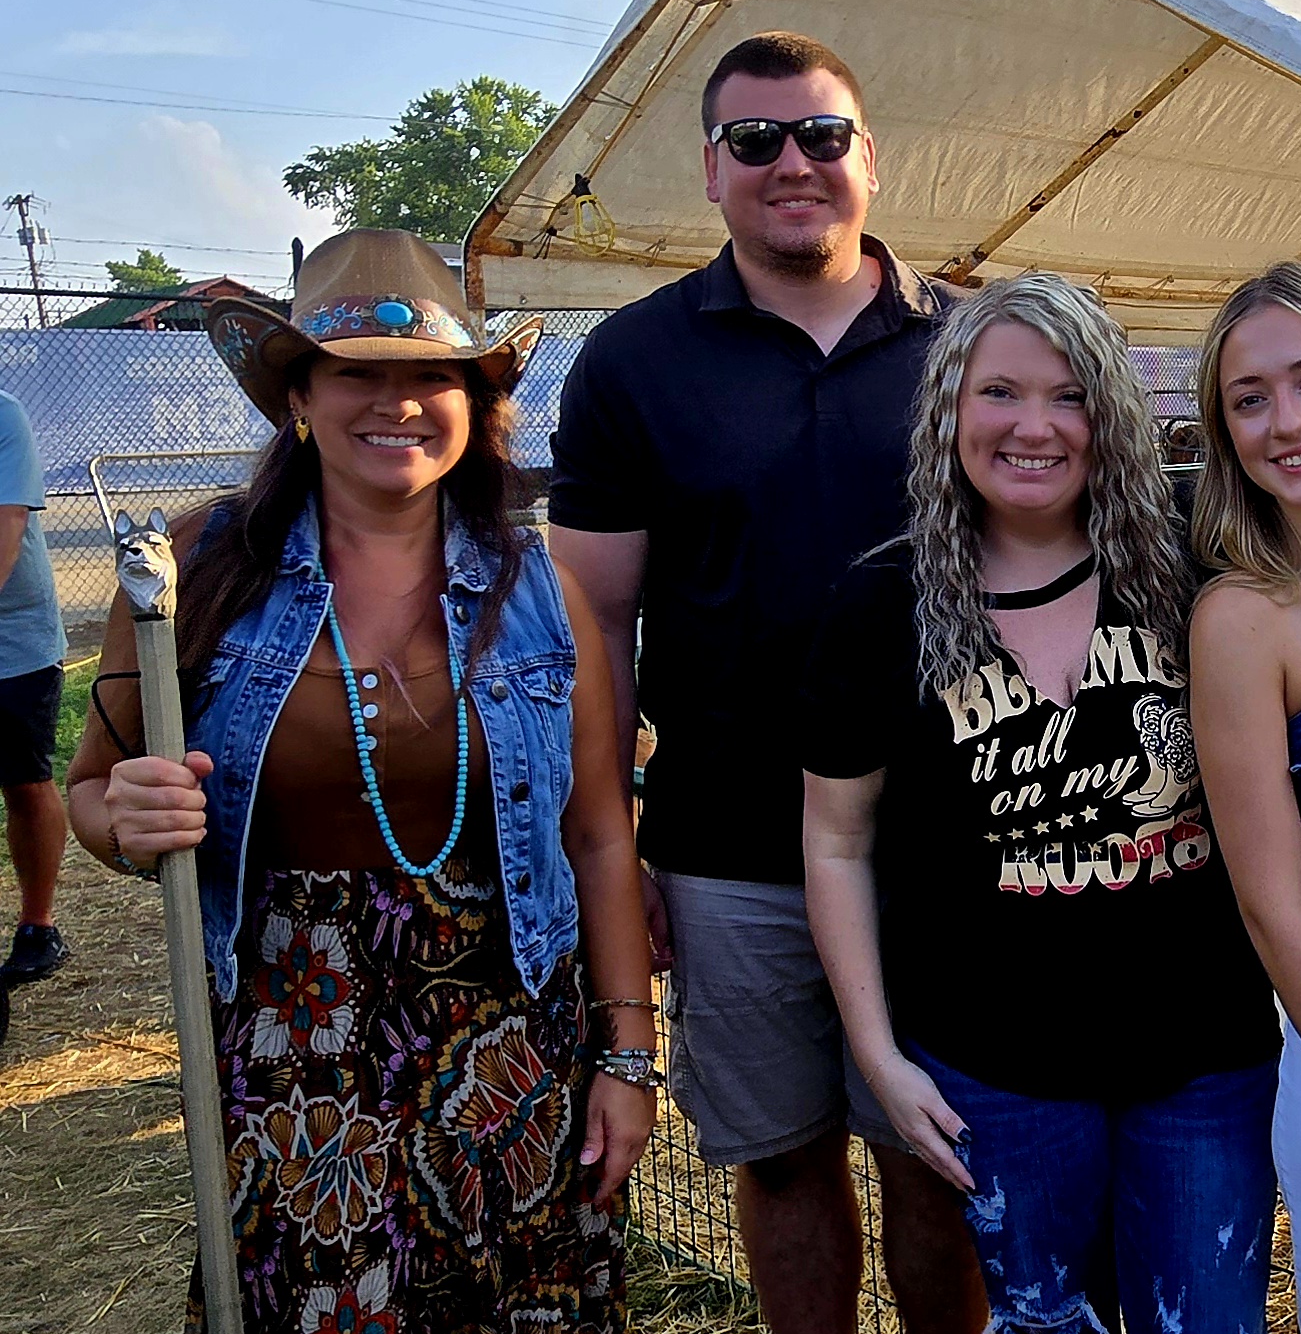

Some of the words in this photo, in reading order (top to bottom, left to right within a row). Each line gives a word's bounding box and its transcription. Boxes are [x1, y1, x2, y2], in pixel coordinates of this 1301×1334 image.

[941, 625, 1189, 744] BLME
[971, 738, 1001, 783] it
[1011, 706, 1077, 776] all
[990, 782, 1046, 816] on
[1060, 754, 1140, 799] my
[998, 803, 1211, 896] ROOTS
